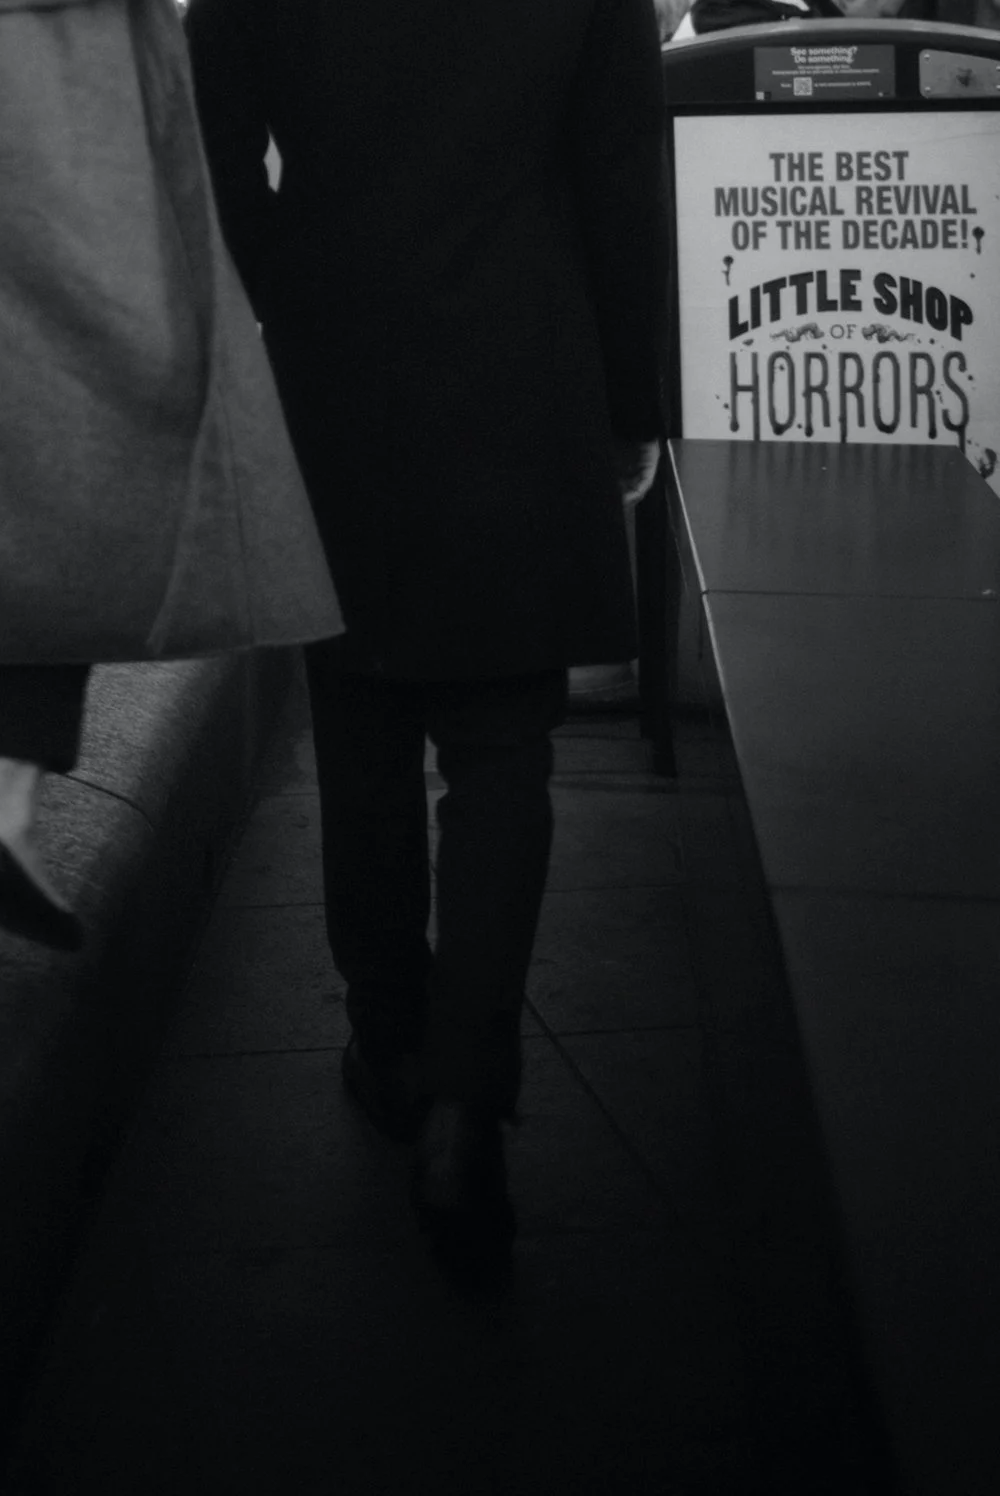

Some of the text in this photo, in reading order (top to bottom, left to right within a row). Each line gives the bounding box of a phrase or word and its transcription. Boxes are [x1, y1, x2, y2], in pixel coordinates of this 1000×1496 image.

[769, 150, 909, 182] THE BEST
[713, 184, 978, 217] MUSICAL REVIVAL
[731, 218, 969, 250] OF THE DECADE!
[728, 269, 974, 342] LITTLE SHOP
[829, 324, 857, 340] OF
[729, 350, 970, 444] HORRORS
